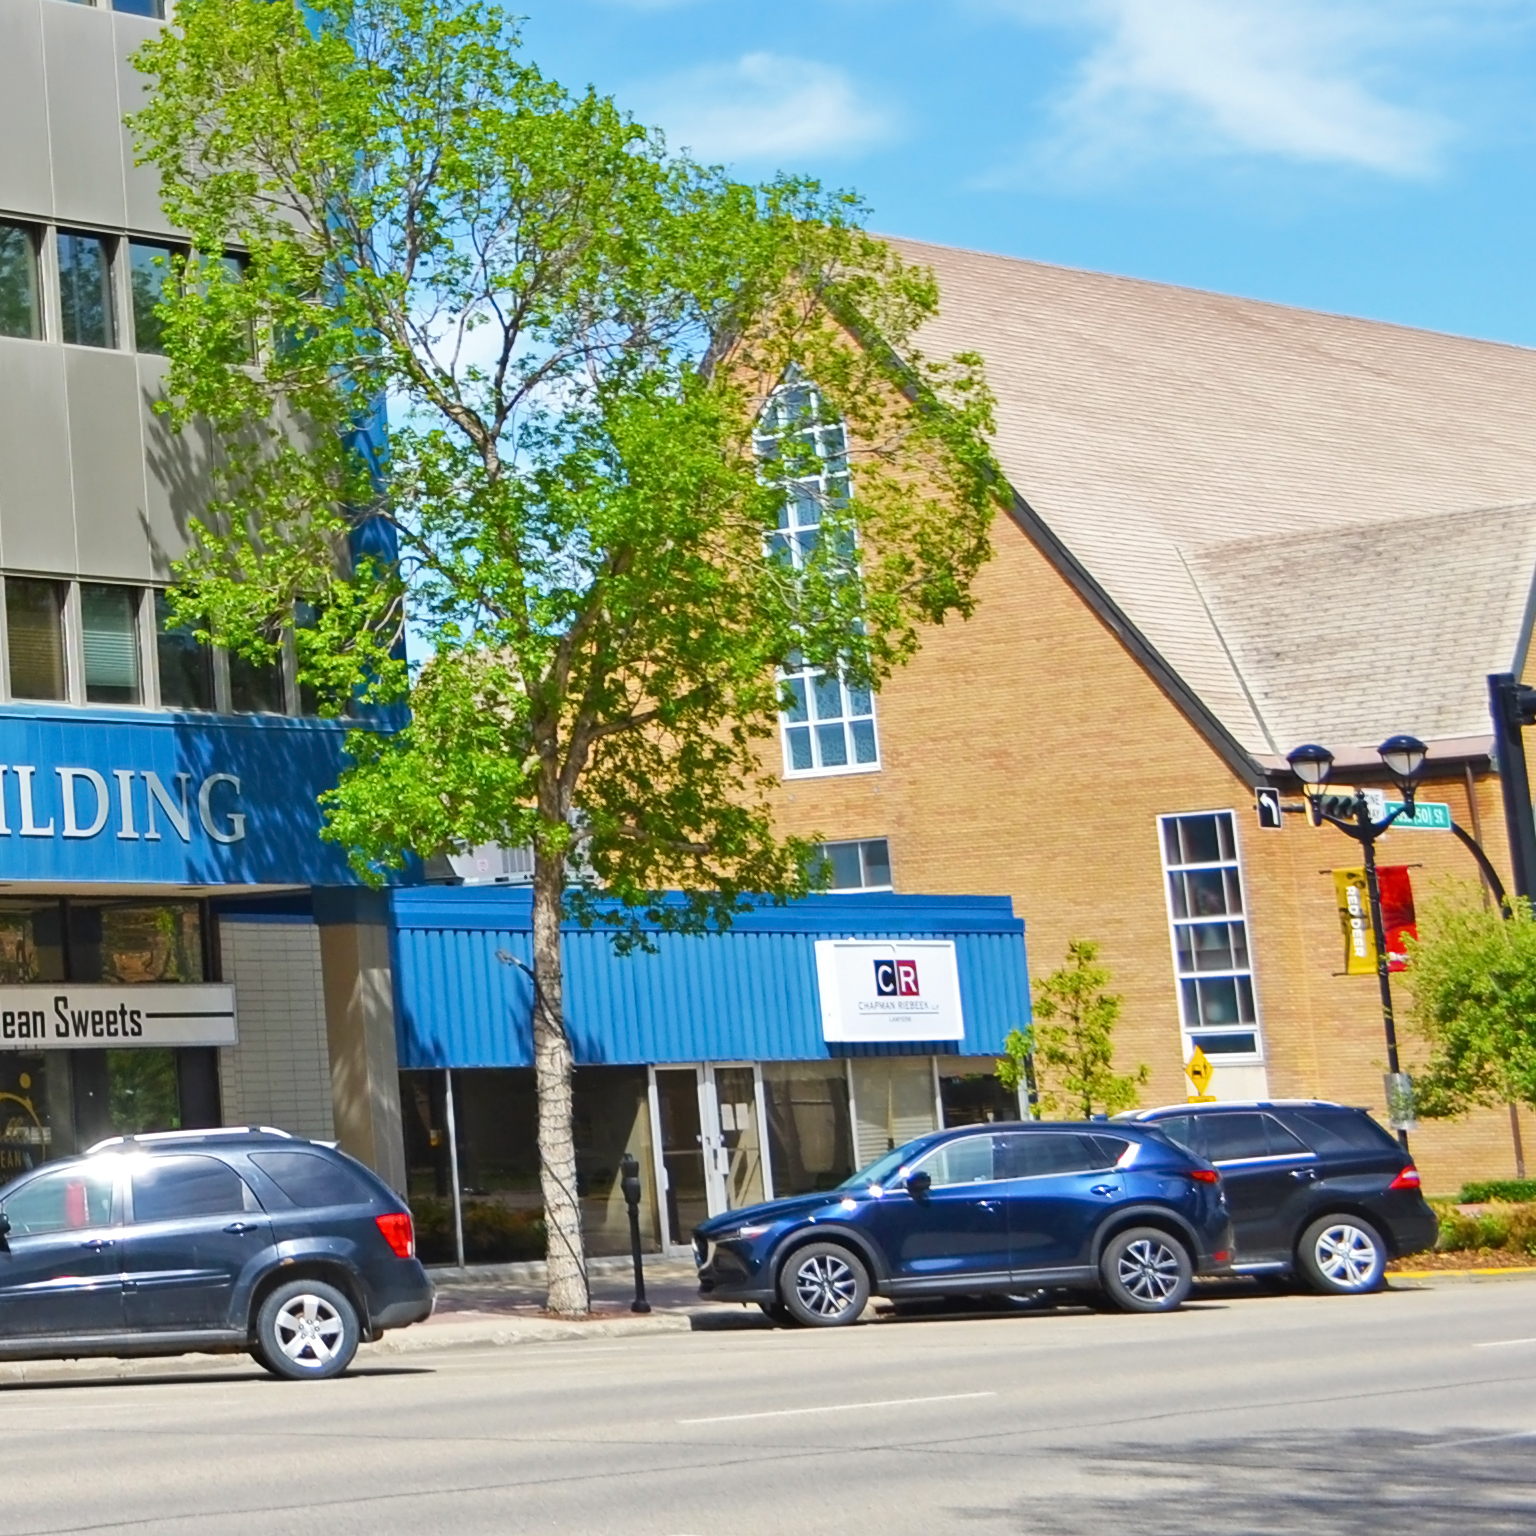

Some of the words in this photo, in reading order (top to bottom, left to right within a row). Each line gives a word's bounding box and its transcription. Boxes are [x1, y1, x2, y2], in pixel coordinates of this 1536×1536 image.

[1346, 885, 1360, 917] RED
[1350, 918, 1367, 958] DEER
[877, 965, 917, 993] CR
[54, 996, 142, 1037] Sweets
[858, 1001, 895, 1010] CHAPMAN
